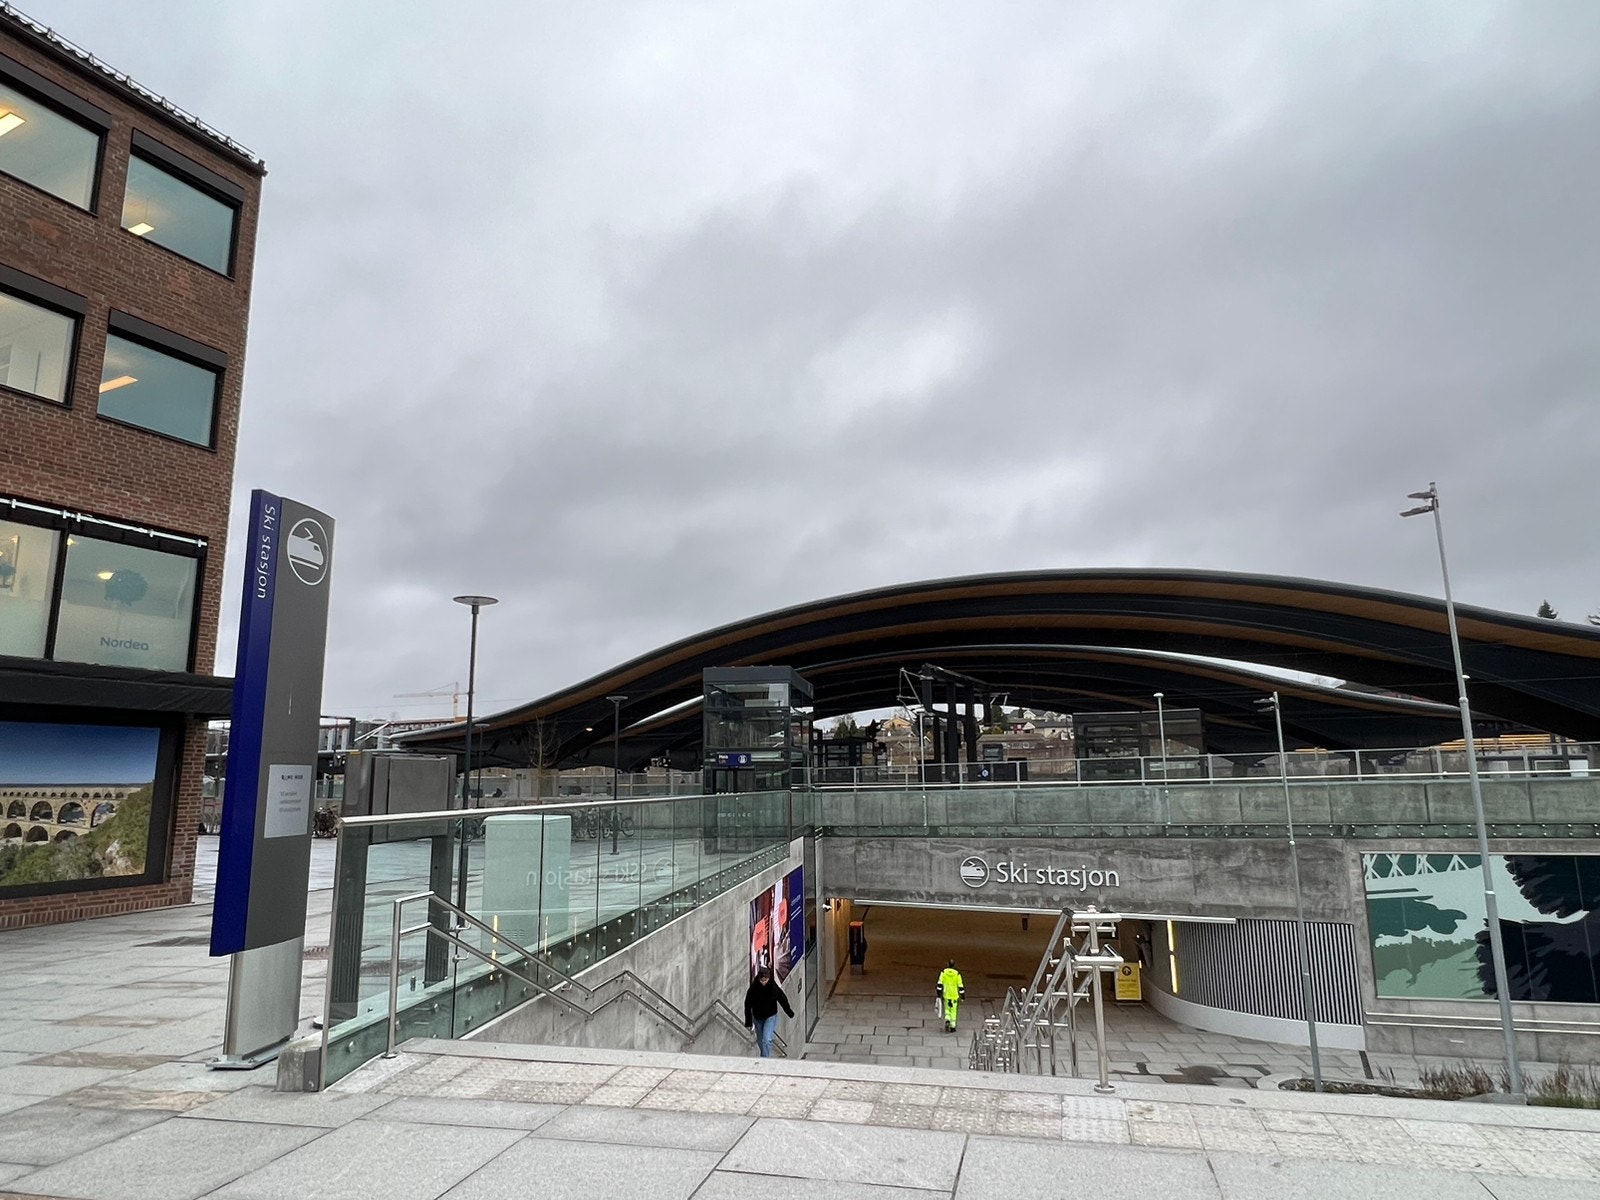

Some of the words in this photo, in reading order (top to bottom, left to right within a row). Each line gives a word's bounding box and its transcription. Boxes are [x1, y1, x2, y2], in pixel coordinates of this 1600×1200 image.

[263, 503, 276, 531] Ski
[256, 534, 271, 599] stasjon
[99, 636, 150, 651] Nordea
[996, 861, 1028, 884] Ski
[1035, 864, 1120, 892] stasjon
